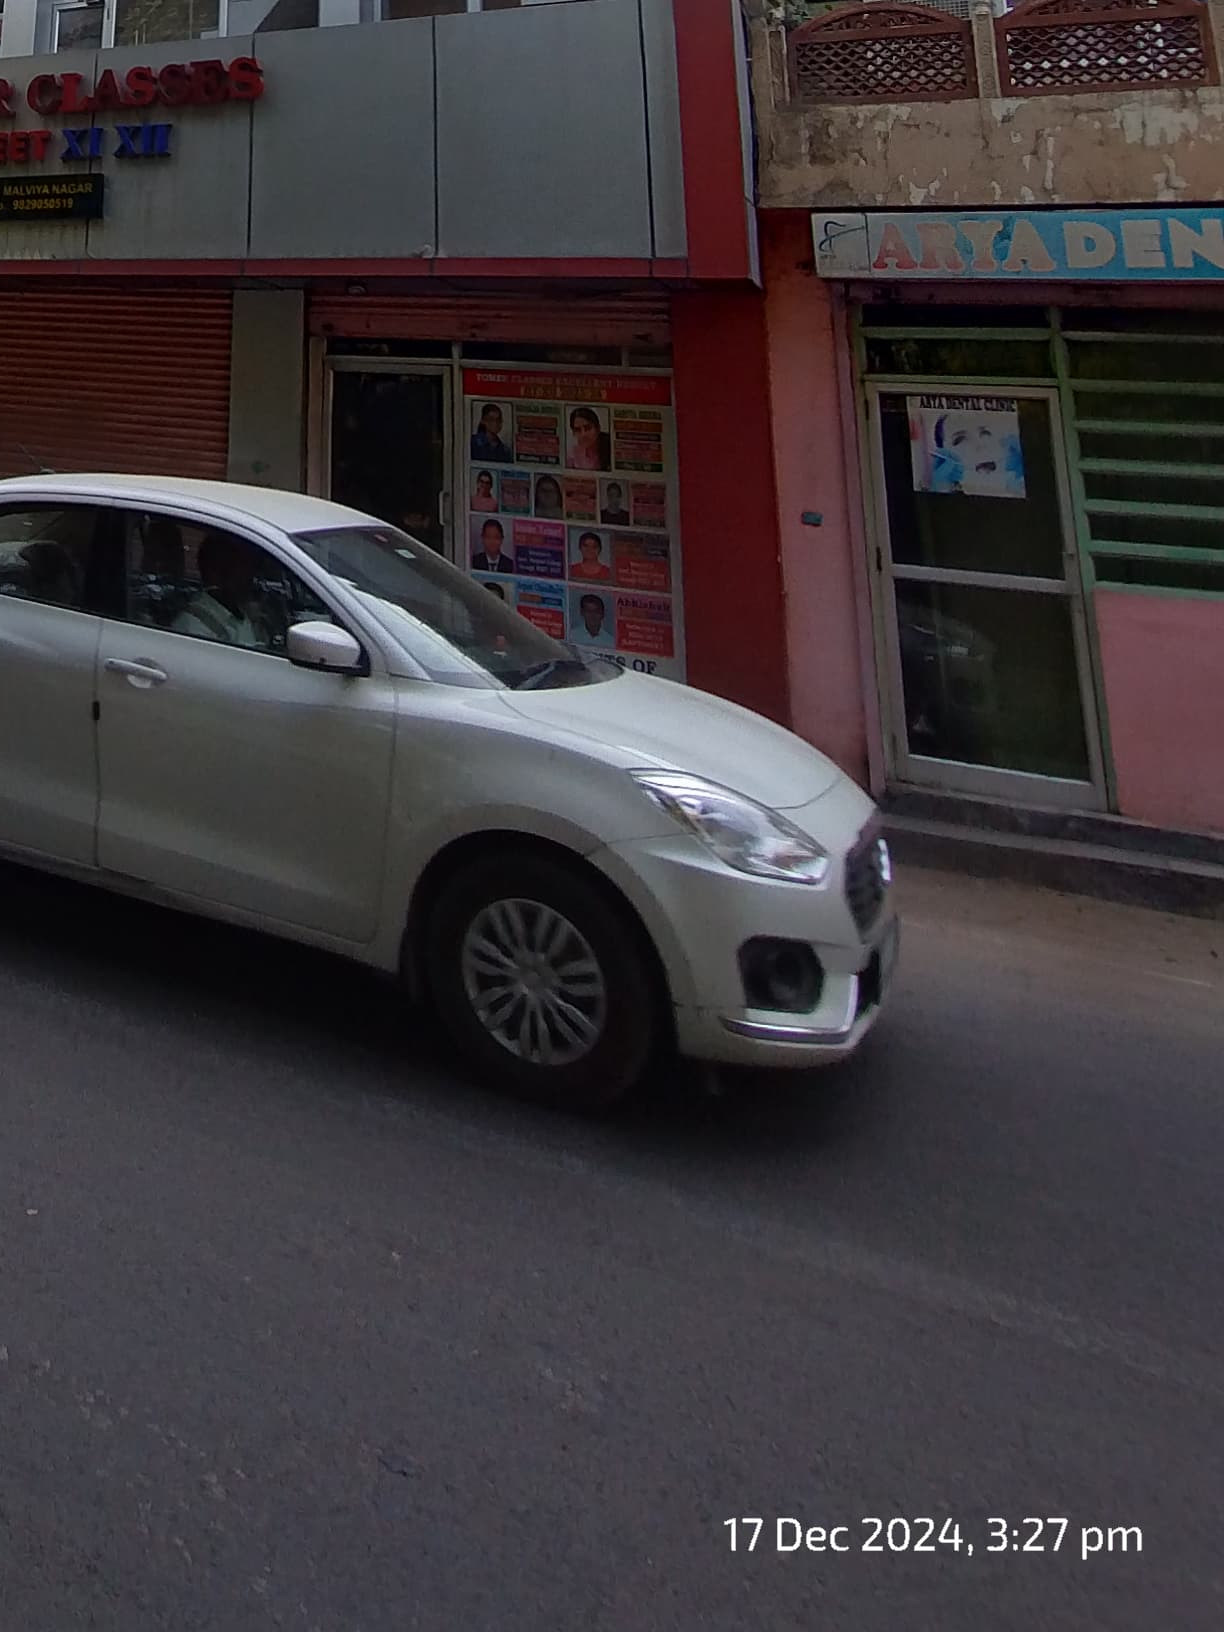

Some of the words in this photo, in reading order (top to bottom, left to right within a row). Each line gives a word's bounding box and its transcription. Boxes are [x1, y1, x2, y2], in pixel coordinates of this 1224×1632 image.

[27, 56, 265, 116] CLASSES
[61, 127, 104, 161] XI
[114, 124, 173, 158] XII
[3, 184, 50, 197] MALVIYA
[52, 182, 93, 195] NAGAR
[872, 218, 1057, 272] ARYA
[1062, 218, 1224, 269] DEN
